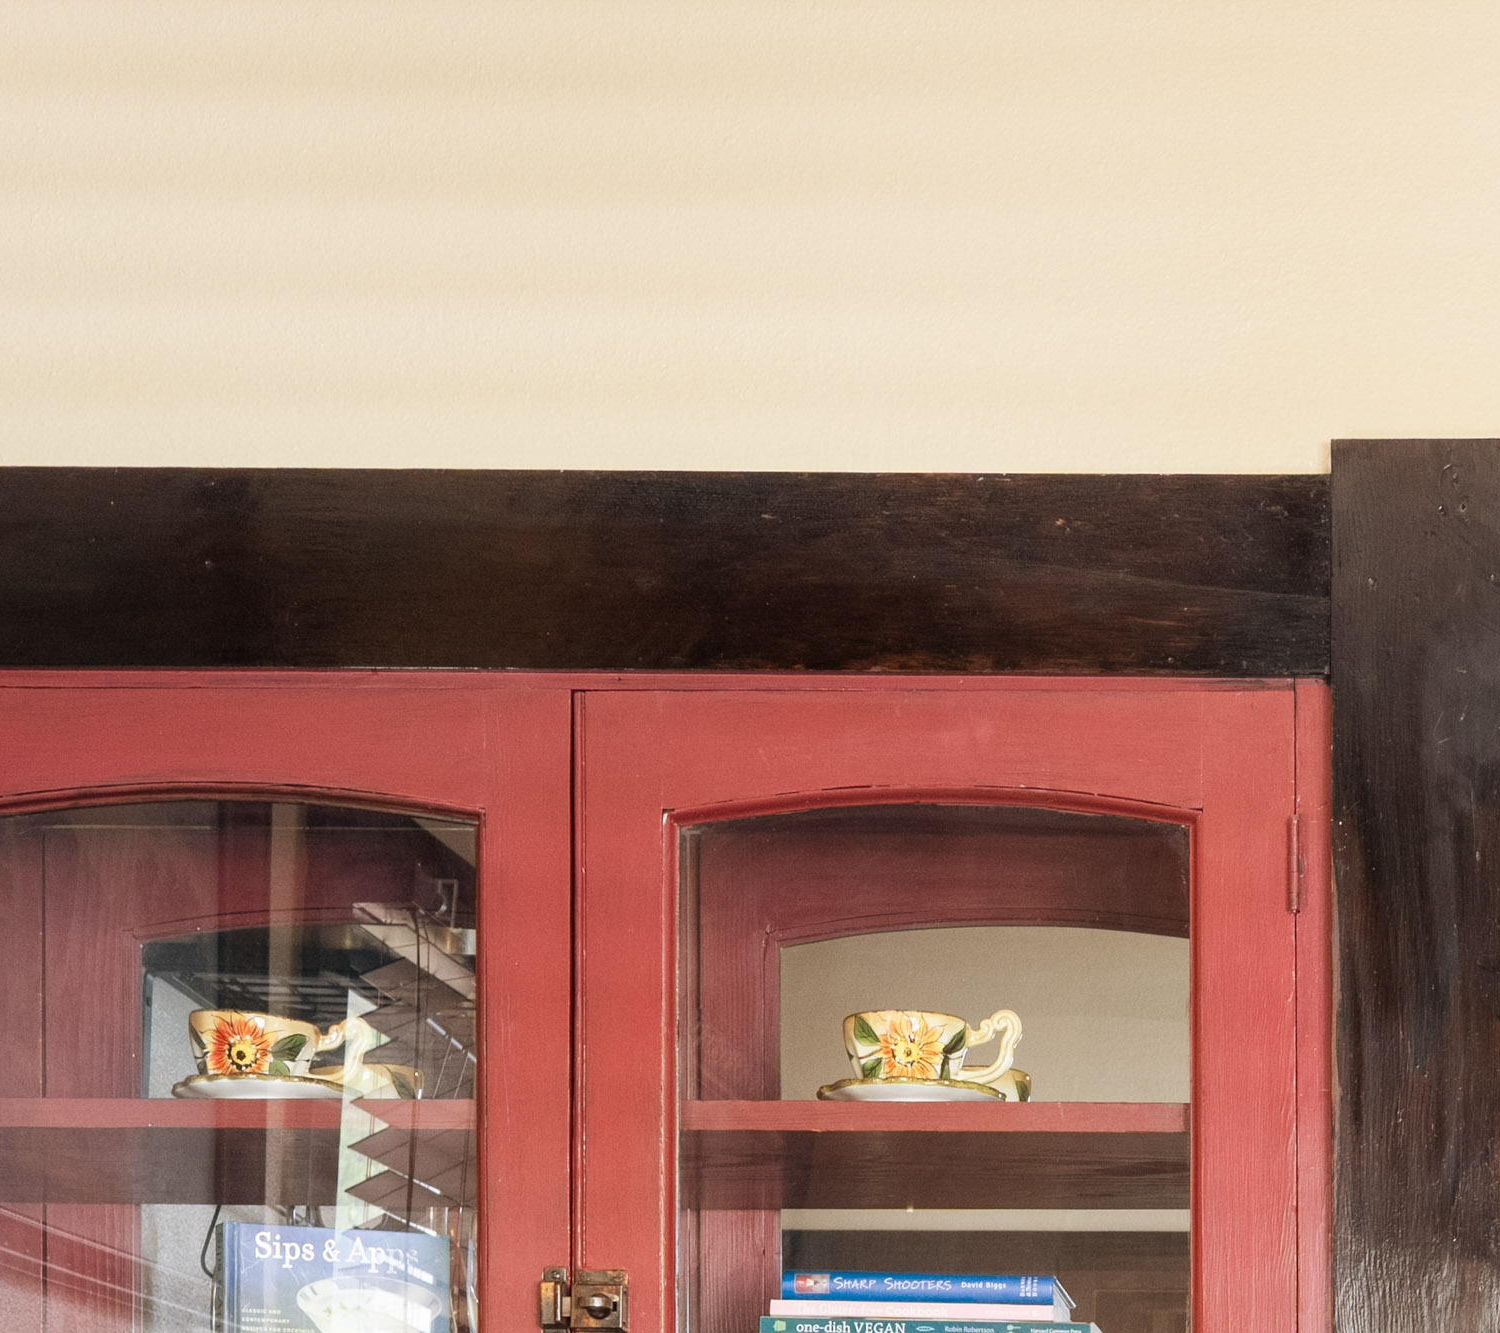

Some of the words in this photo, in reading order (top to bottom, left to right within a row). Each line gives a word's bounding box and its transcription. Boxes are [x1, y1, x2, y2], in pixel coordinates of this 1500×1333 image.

[255, 1231, 315, 1268] Sips
[322, 1239, 340, 1262] &
[345, 1236, 419, 1274] Apps
[833, 1276, 876, 1290] SHARP
[884, 1277, 952, 1291] SHOOTERS
[961, 1281, 983, 1289] David
[986, 1282, 1006, 1290] Biggs
[796, 1321, 851, 1333] one-dish
[963, 1326, 994, 1333] Robertson
